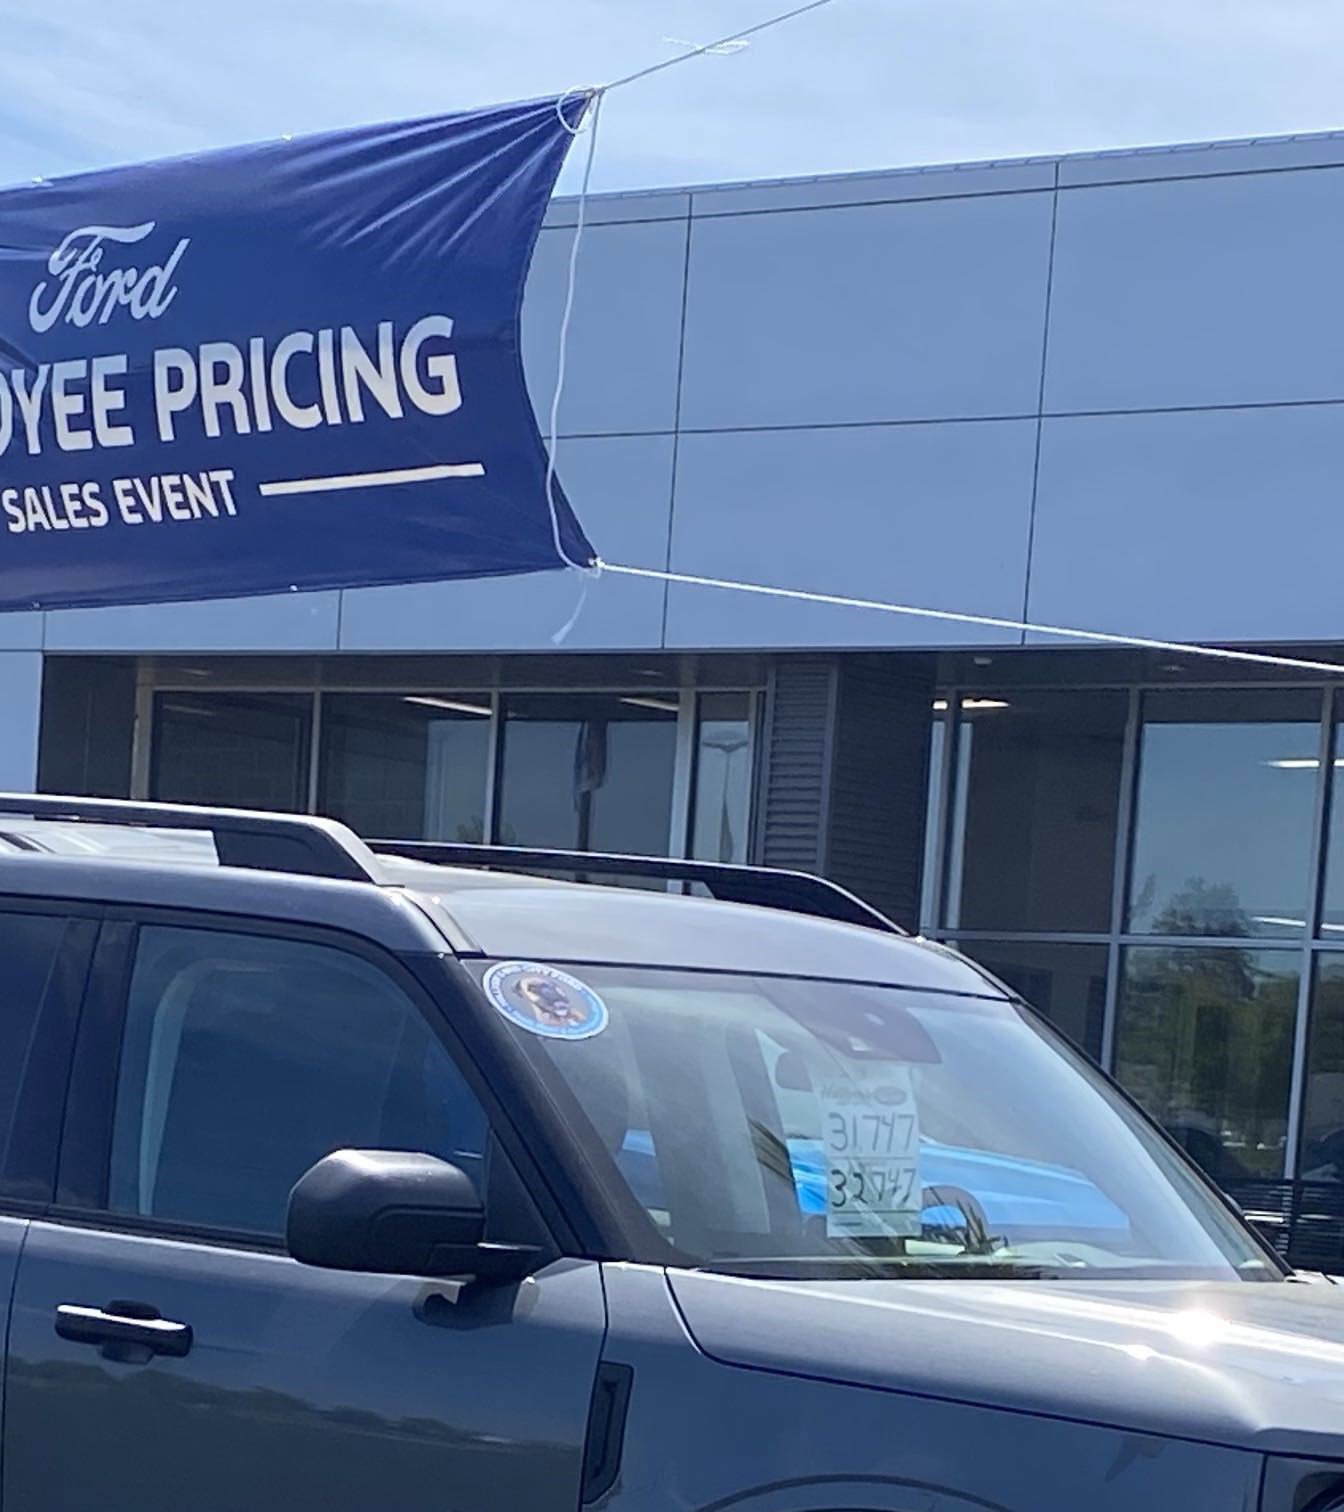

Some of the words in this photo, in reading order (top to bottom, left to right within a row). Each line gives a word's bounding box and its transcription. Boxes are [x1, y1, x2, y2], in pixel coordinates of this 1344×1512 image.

[28, 220, 191, 333] Ford
[153, 314, 462, 442] PRICING
[0, 481, 109, 533] SALES
[121, 469, 238, 524] EVENT
